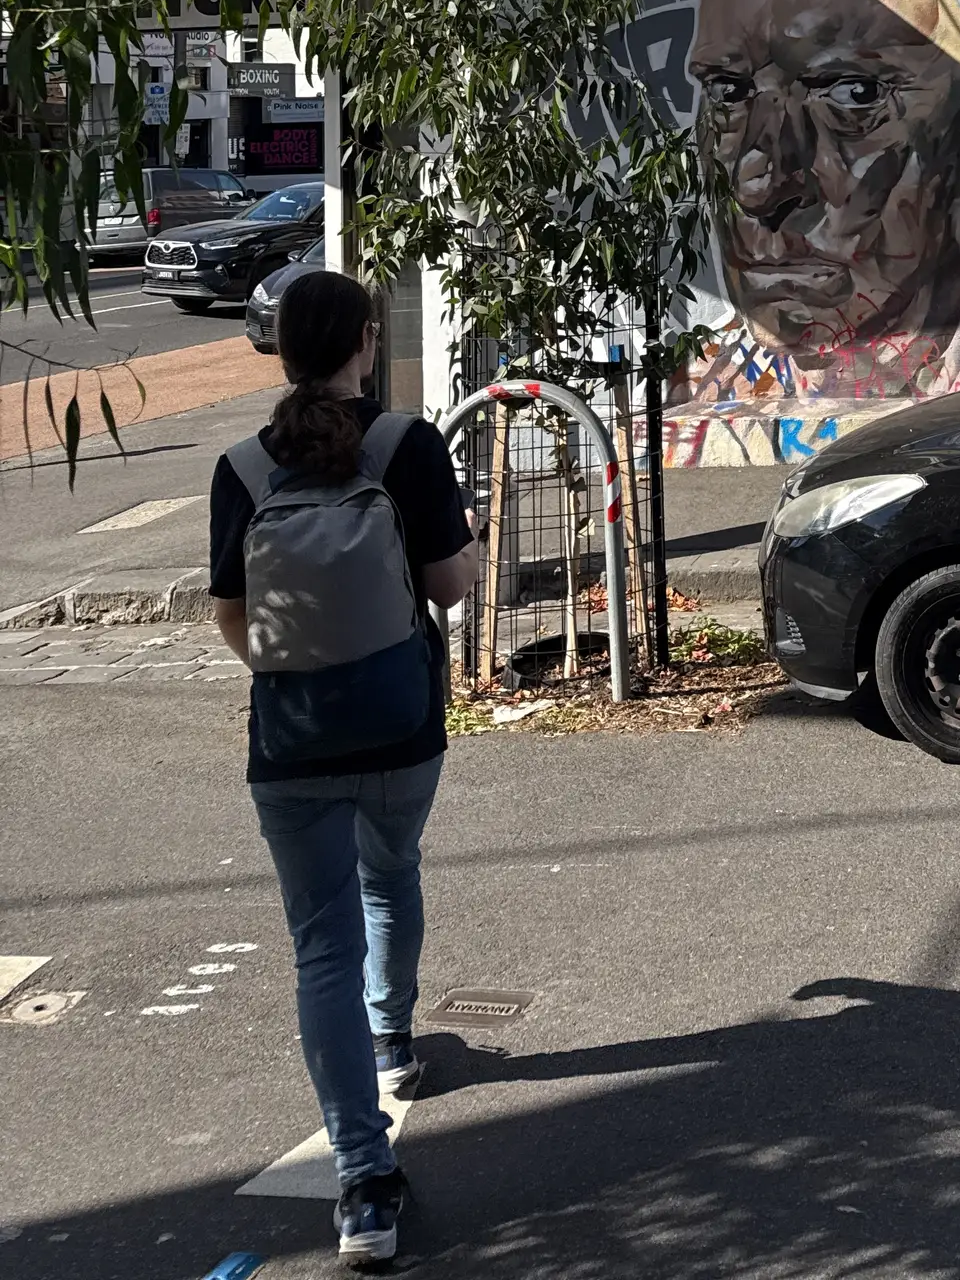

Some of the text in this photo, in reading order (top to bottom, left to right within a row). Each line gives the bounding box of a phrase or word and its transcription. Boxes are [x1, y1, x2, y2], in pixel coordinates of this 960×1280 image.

[240, 69, 280, 84] BOXING
[273, 129, 309, 141] BODY
[250, 140, 309, 154] ELECTRIC
[264, 152, 309, 165] DANCE
[445, 1000, 516, 1014] HYDRANT
